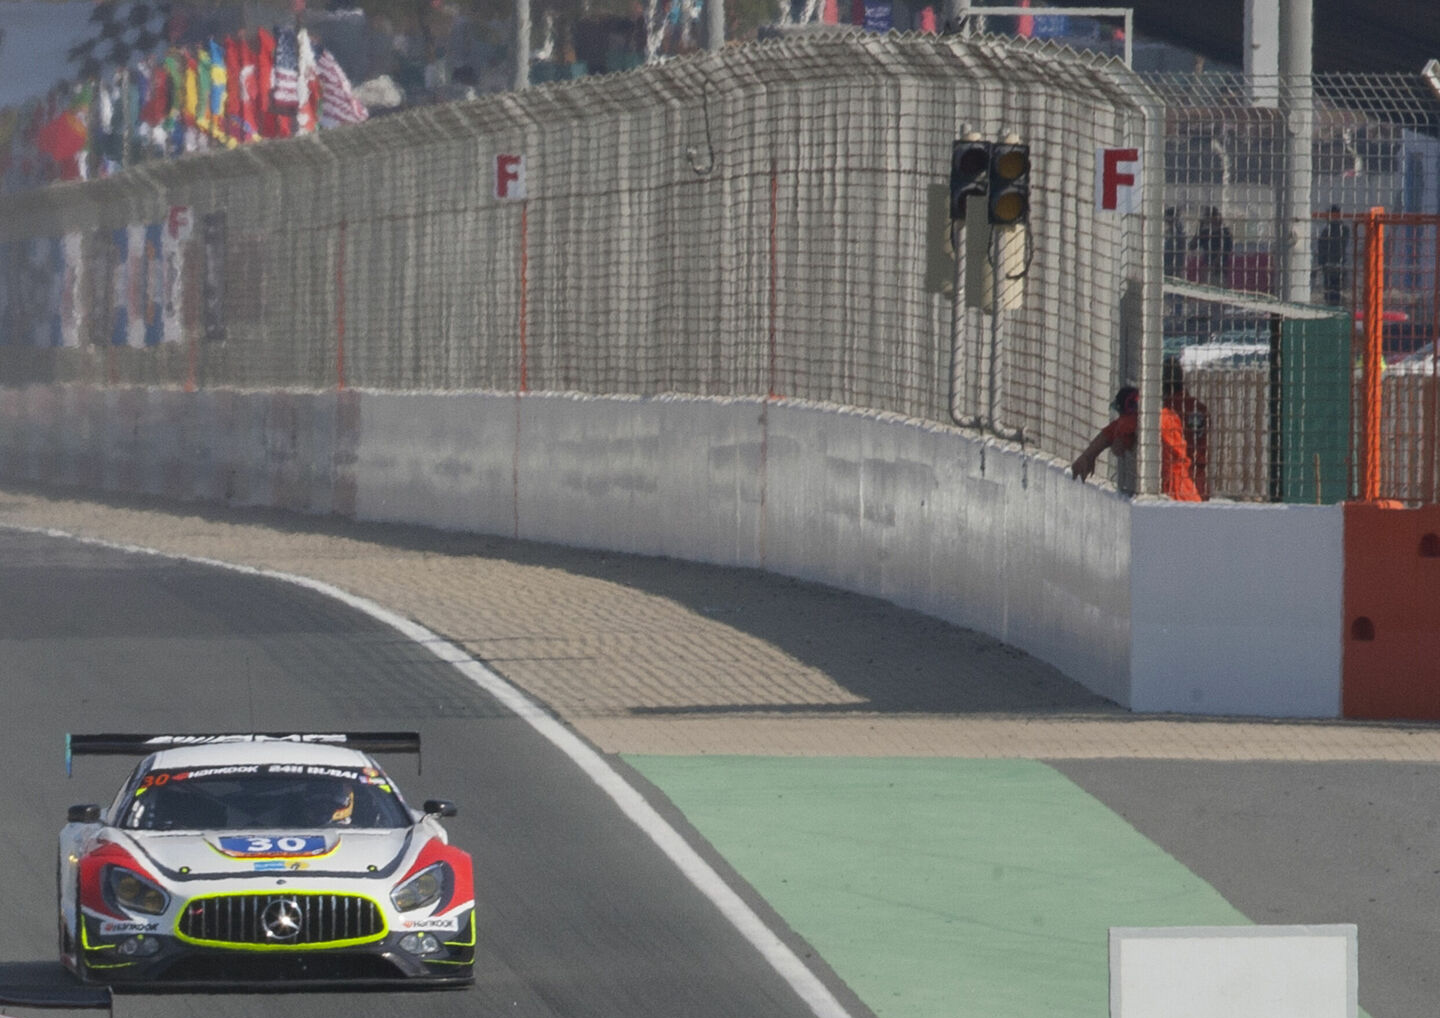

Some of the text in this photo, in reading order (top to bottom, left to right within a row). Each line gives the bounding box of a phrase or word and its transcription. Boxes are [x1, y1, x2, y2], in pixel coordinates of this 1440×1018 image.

[496, 153, 522, 198] F
[1101, 148, 1139, 211] F
[143, 774, 170, 788] 30
[246, 837, 308, 852] 30
